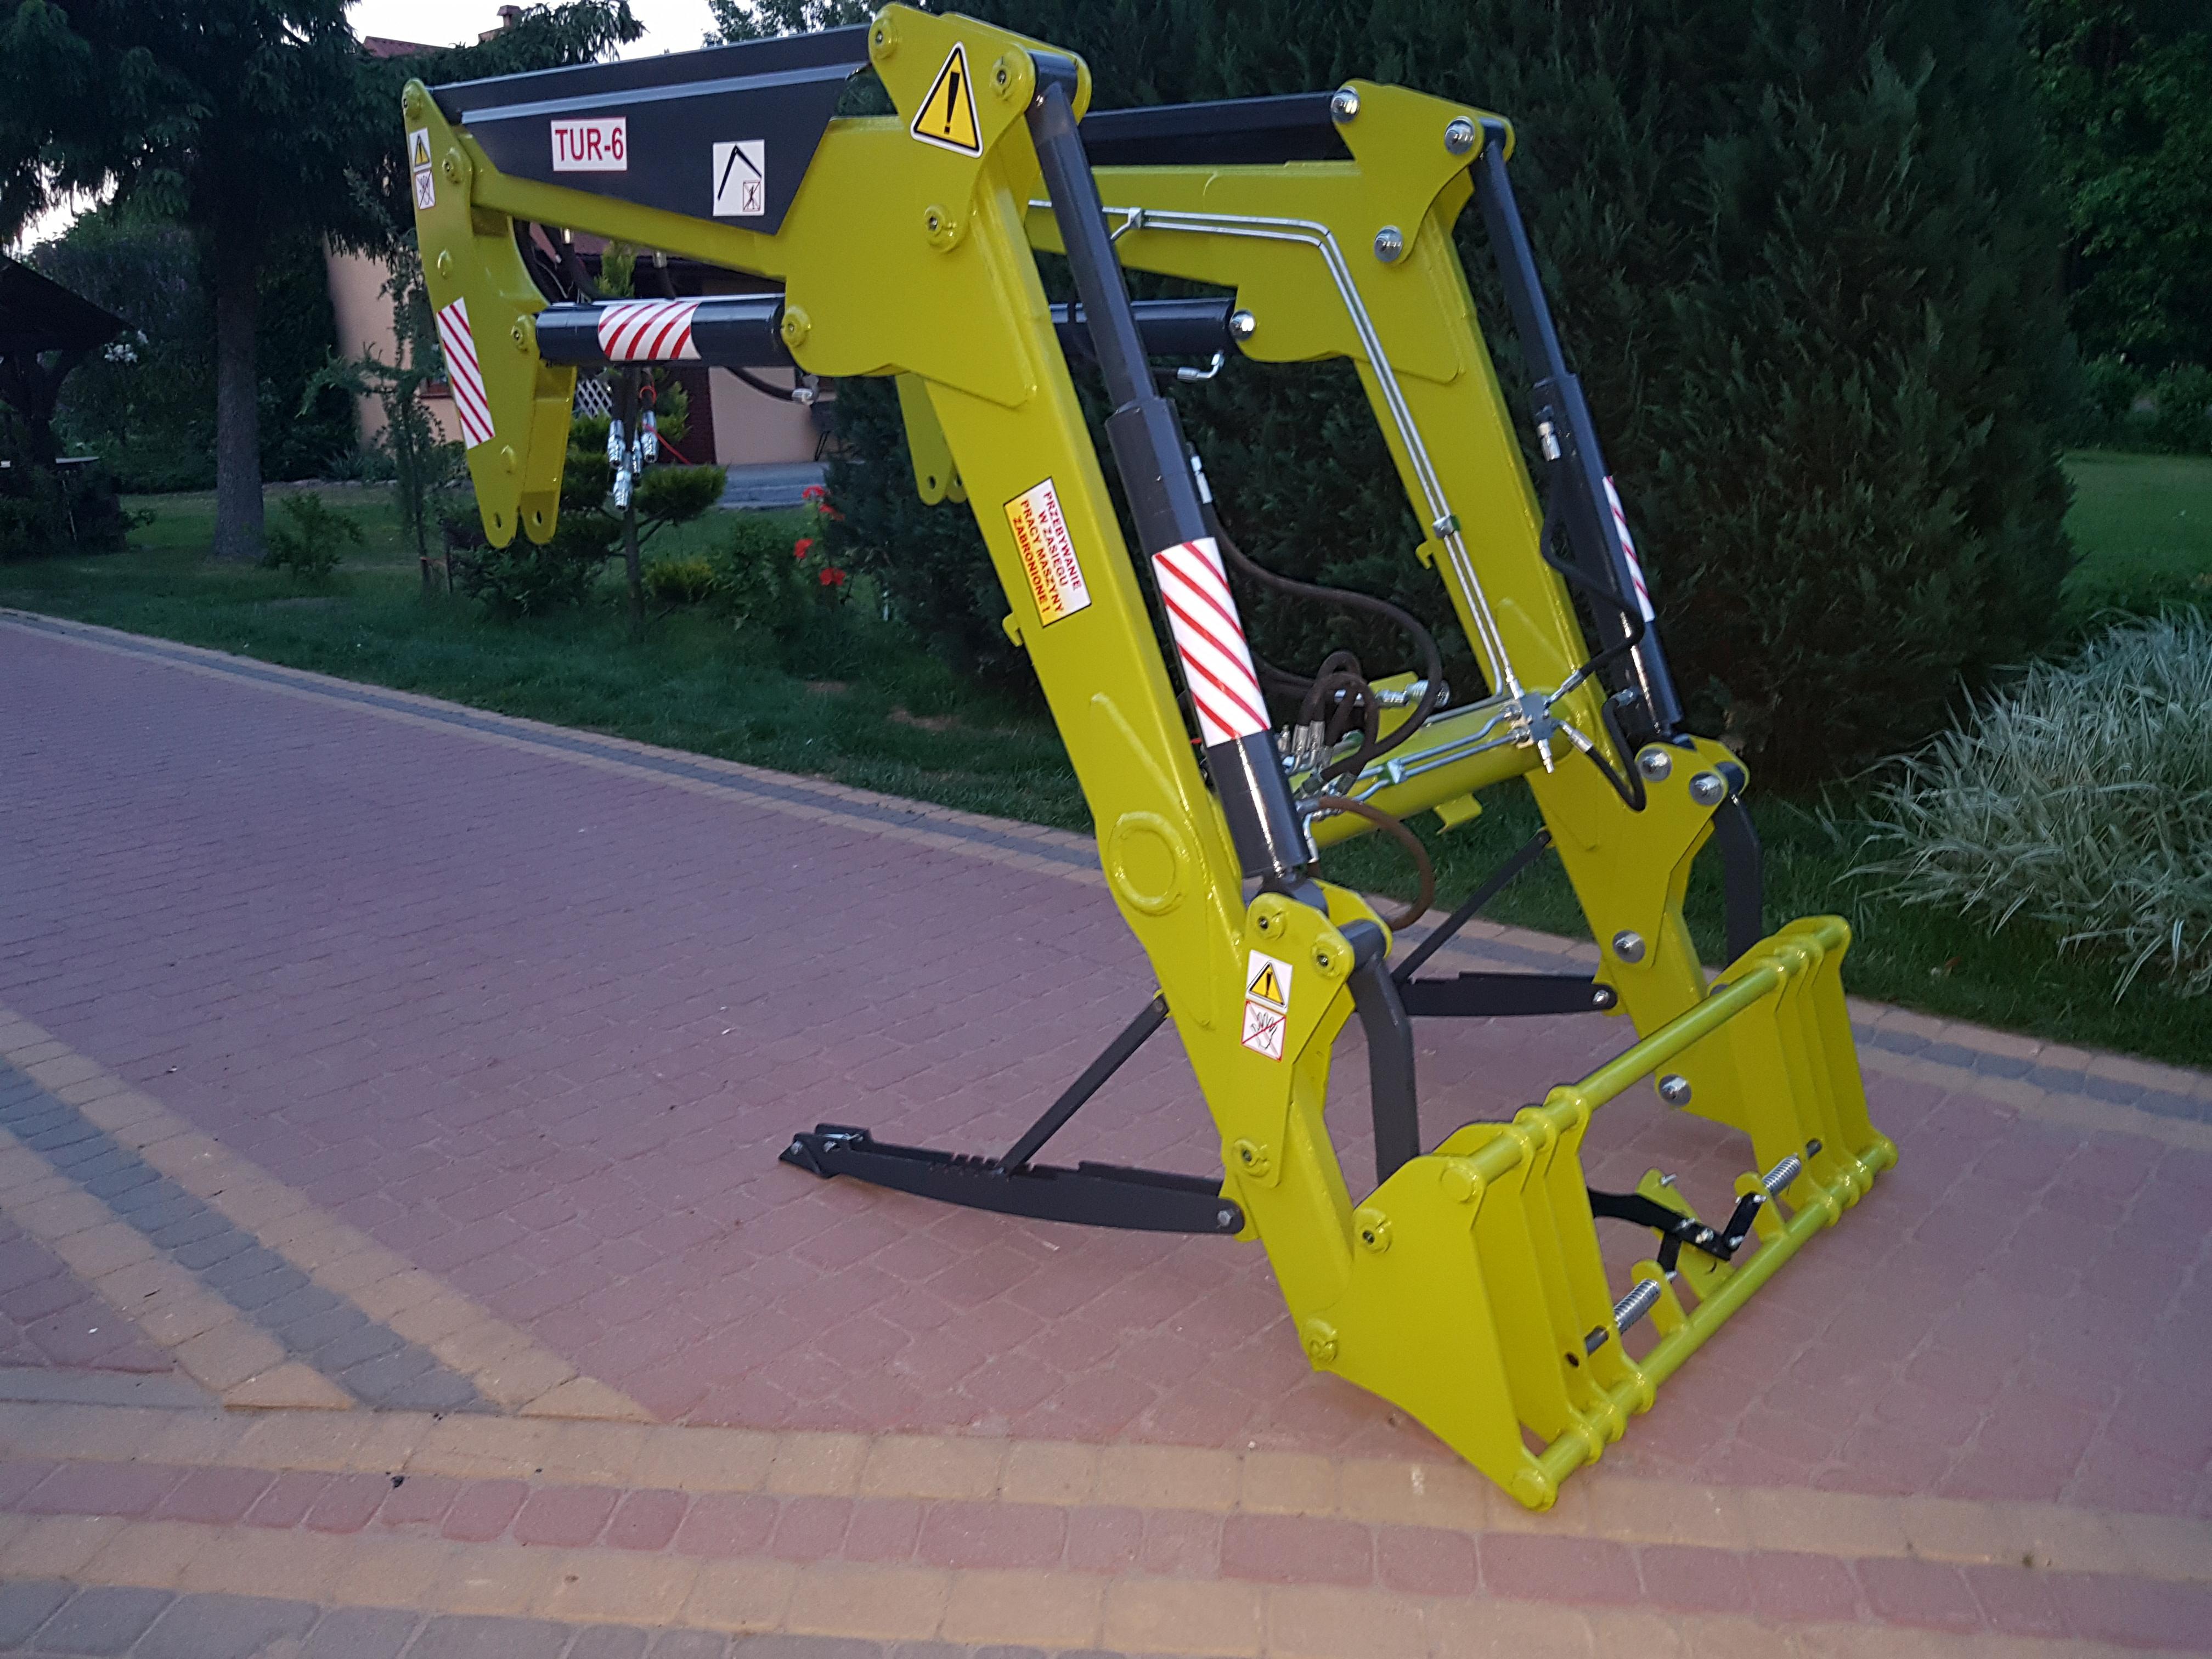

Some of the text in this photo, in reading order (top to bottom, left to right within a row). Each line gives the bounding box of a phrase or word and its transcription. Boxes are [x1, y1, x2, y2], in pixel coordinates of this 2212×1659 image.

[555, 127, 624, 161] TUR-6
[1013, 515, 1048, 604] ZABRONIONE
[1020, 499, 1064, 613] PRACY MASZYNY
[1039, 510, 1048, 523] W
[1043, 491, 1082, 591] PRZEBYWANIE
